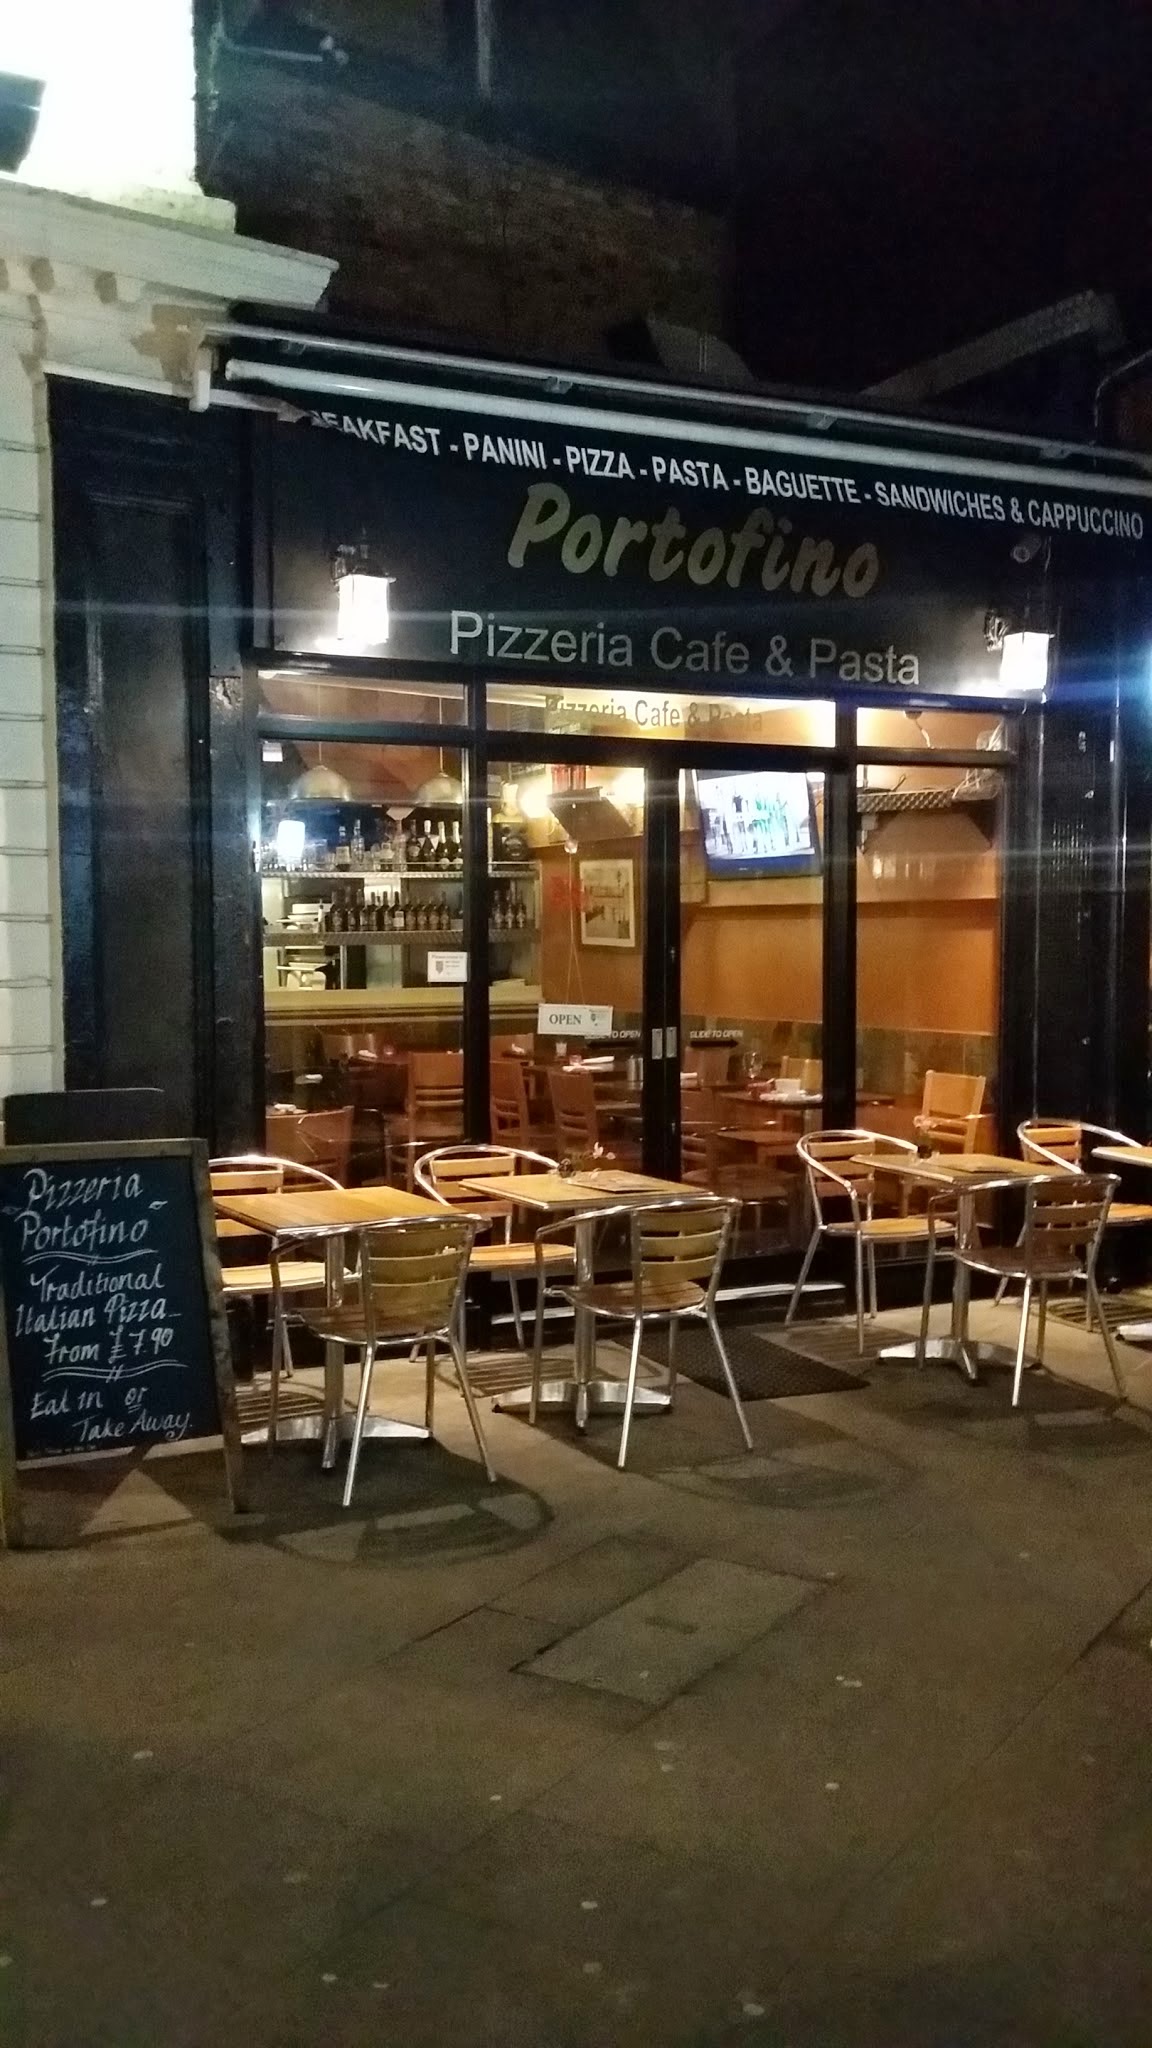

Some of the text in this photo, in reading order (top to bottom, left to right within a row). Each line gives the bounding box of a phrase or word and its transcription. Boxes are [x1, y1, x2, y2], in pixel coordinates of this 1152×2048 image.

[462, 432, 548, 470] PANINI
[565, 445, 636, 480] PIZZA
[651, 456, 730, 491] PASTA
[744, 466, 862, 504] BAGUETTE
[874, 481, 1006, 521] SANDWICHES
[1010, 496, 1026, 524] &
[1027, 499, 1144, 540] CAPPUCCINO
[506, 482, 880, 598] Portofino
[450, 609, 921, 686] Pizzeria Cafe & Pasta
[634, 699, 681, 728] Cafe
[687, 701, 699, 729] &
[549, 1013, 582, 1025] OPEN
[23, 1168, 144, 1212] Pizzeria
[14, 1209, 149, 1251] Portofino
[30, 1262, 165, 1303] Traditional
[16, 1303, 97, 1337] Italian
[43, 1332, 100, 1364] From
[30, 1388, 70, 1420] Eat
[124, 1387, 149, 1406] or
[72, 1414, 126, 1443] Take
